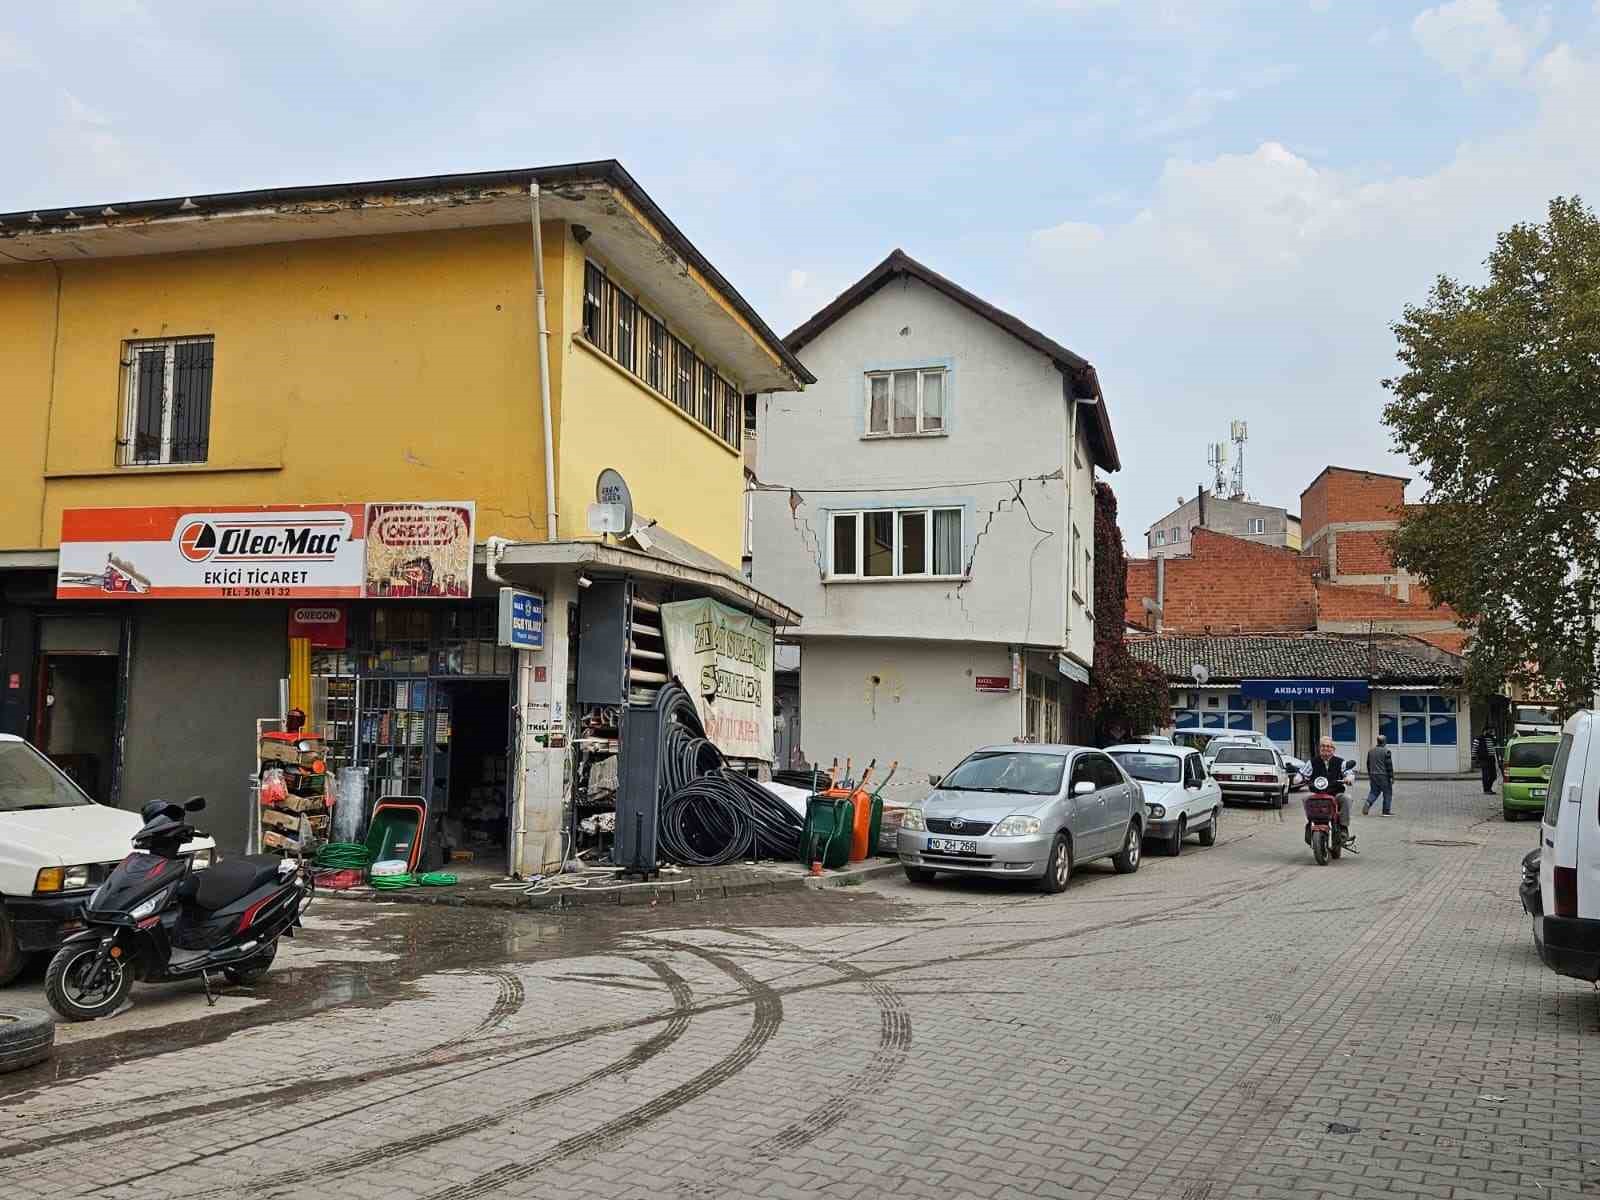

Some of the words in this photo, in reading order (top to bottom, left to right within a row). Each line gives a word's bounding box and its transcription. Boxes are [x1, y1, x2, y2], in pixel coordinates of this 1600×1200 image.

[219, 528, 341, 555] Oleo-Mac
[204, 568, 242, 584] EKİCİ
[247, 567, 308, 584] TİCARET
[221, 587, 241, 597] TEL:
[244, 587, 261, 597] 516
[264, 587, 275, 597] 41
[277, 587, 290, 597] 32
[1315, 684, 1335, 695] YERİ
